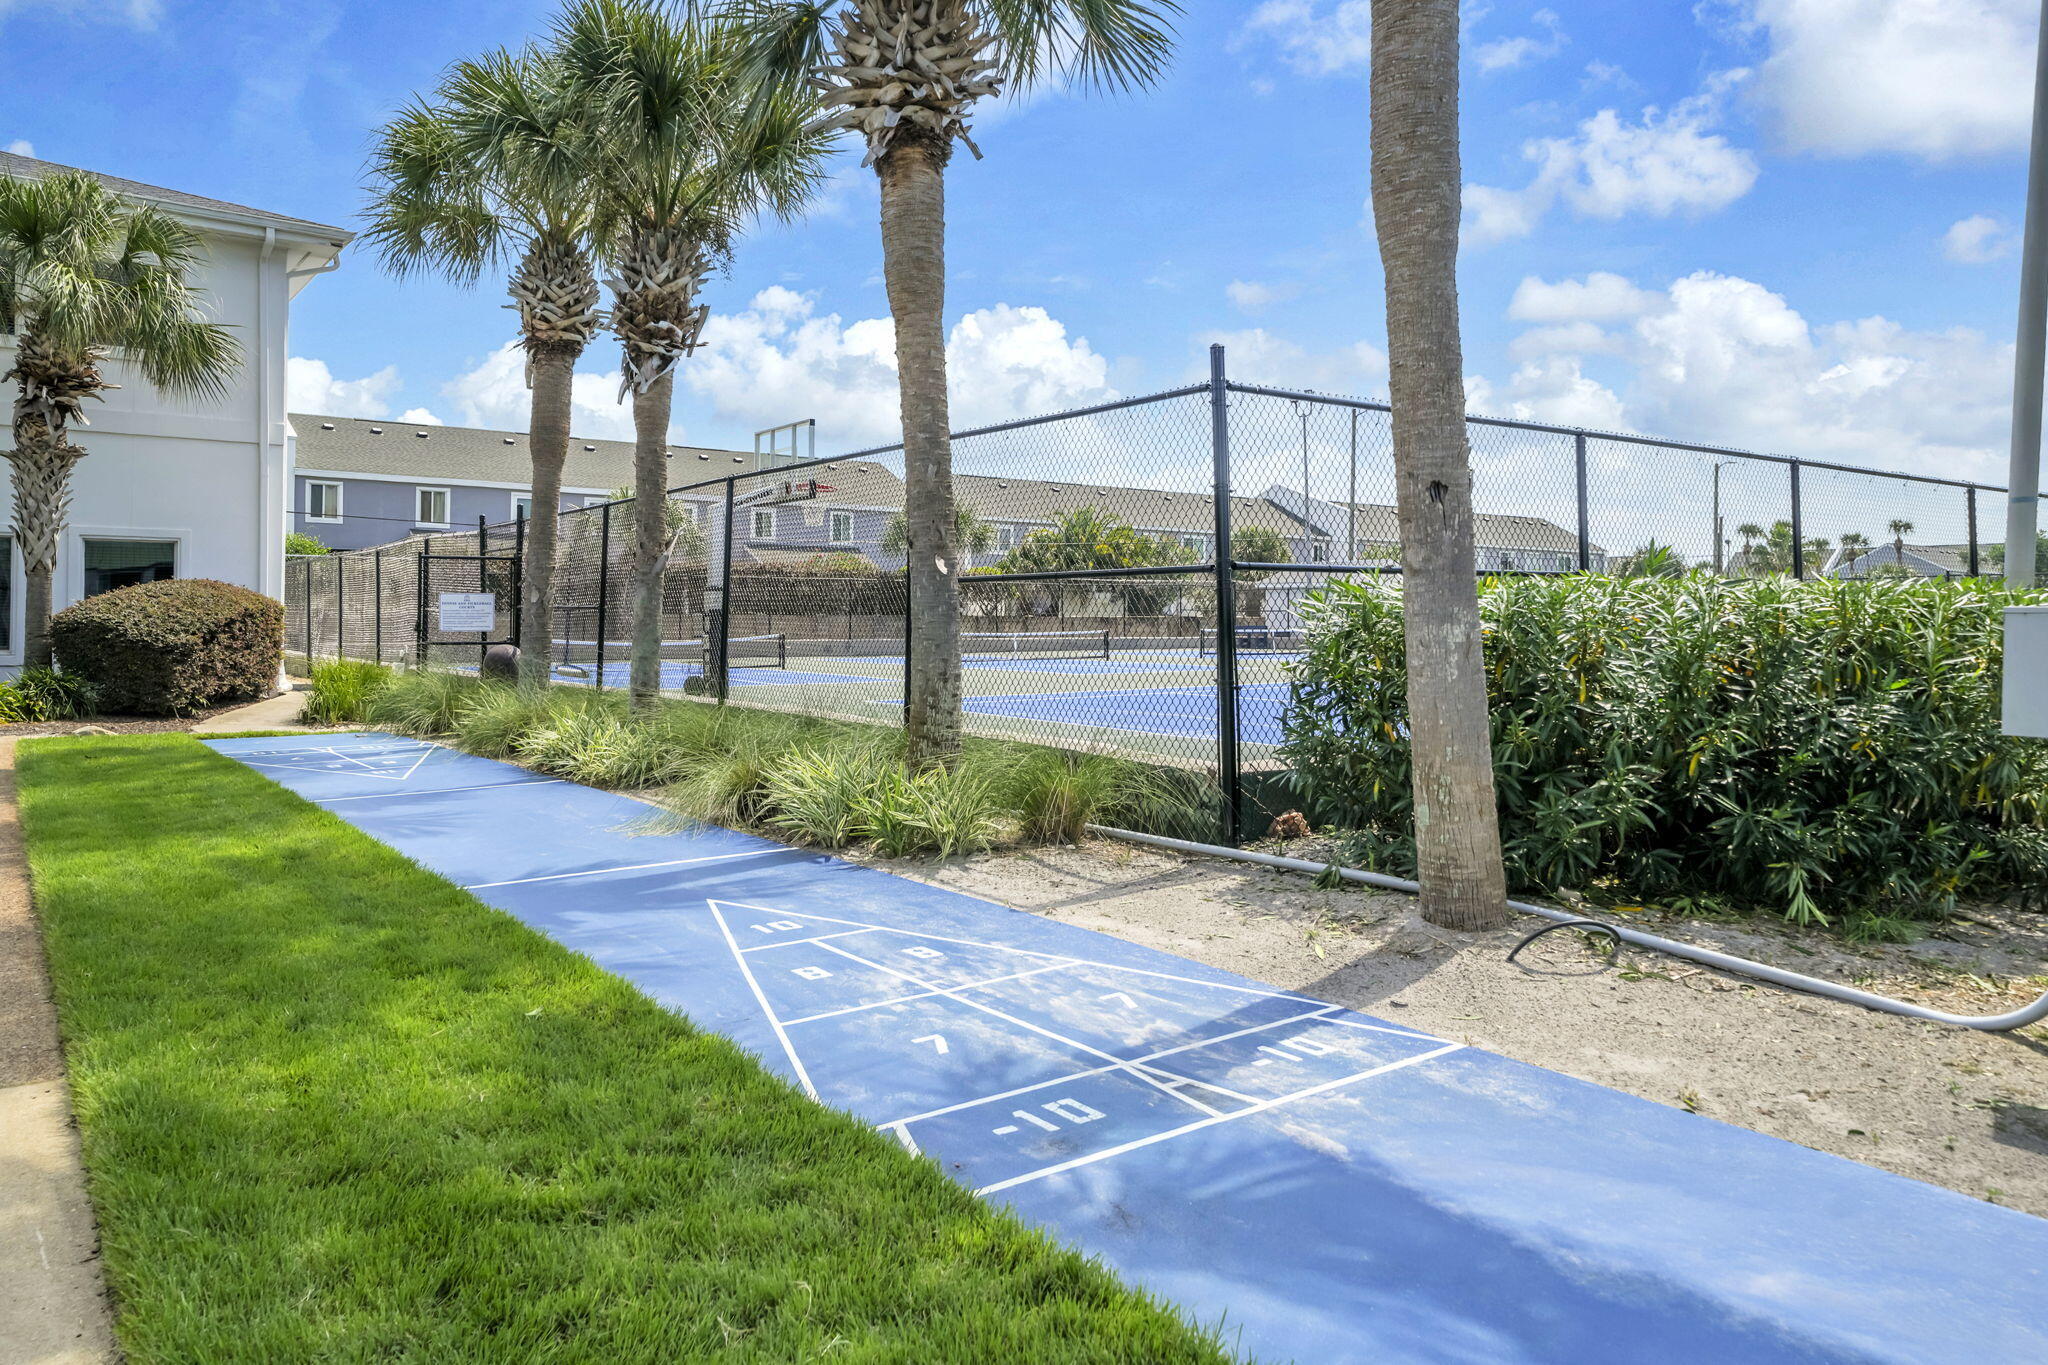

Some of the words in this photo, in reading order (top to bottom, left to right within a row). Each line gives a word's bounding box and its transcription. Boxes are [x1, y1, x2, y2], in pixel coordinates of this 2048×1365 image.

[750, 920, 804, 934] 10
[901, 946, 945, 959] 8
[790, 966, 834, 980] 8
[1099, 991, 1138, 1009] 7
[910, 1034, 949, 1055] 7
[992, 1098, 1106, 1135] -10
